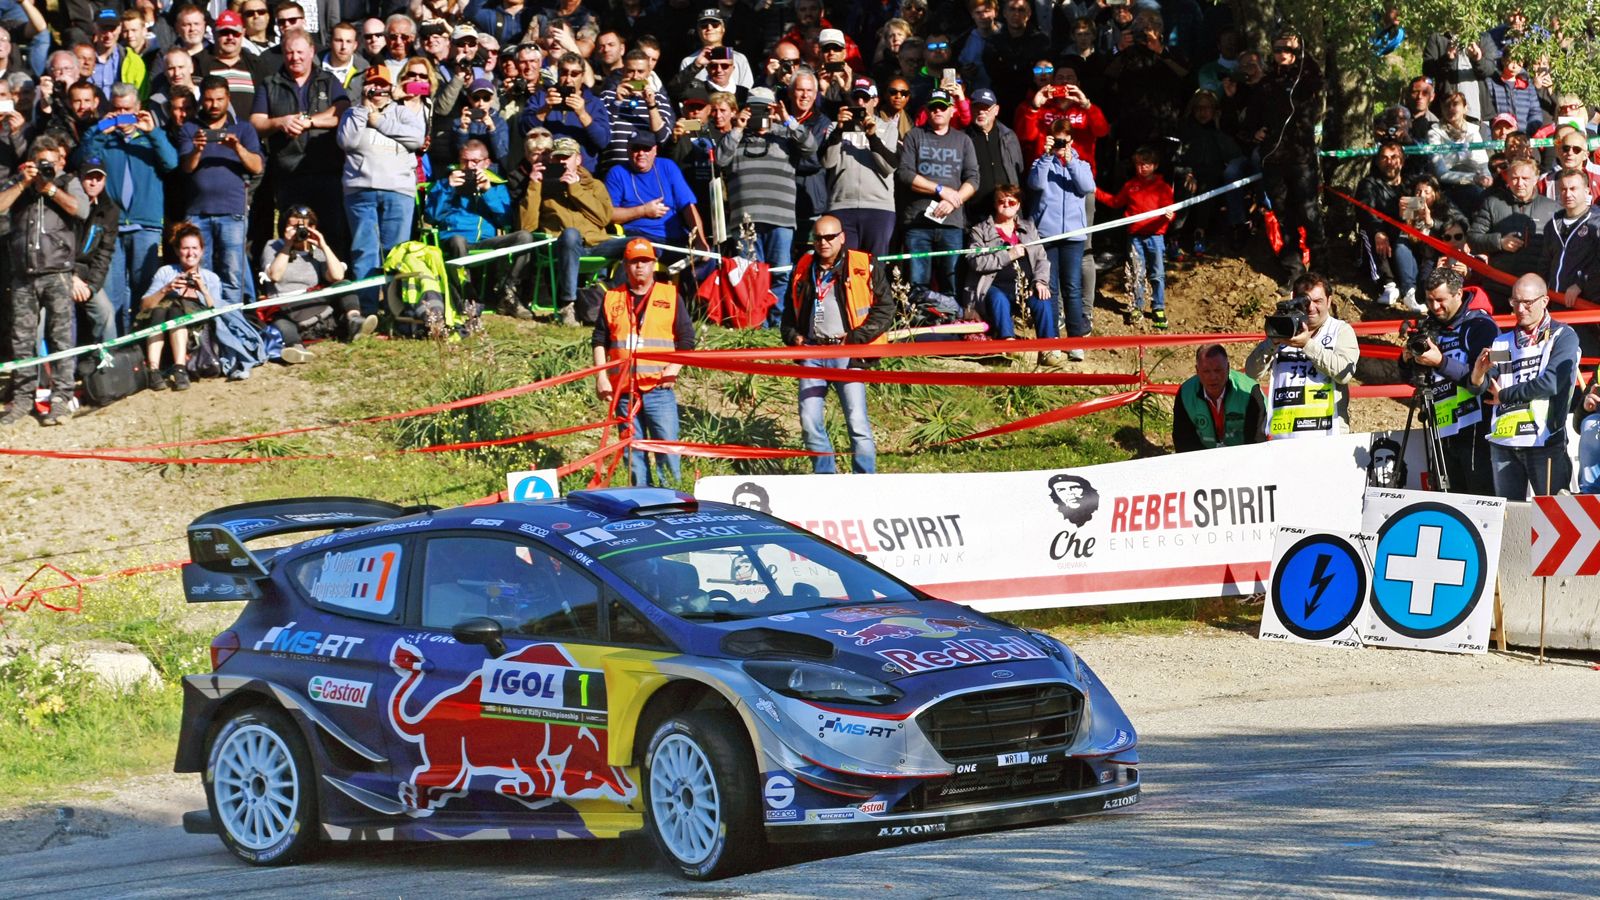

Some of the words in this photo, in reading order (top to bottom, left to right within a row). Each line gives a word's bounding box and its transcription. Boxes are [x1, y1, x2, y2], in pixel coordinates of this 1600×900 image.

[919, 145, 963, 163] EXPL
[918, 161, 953, 178] ORE
[1290, 365, 1318, 380] 334
[1274, 389, 1302, 401] Lexar
[1431, 382, 1453, 395] exar
[1272, 421, 1292, 431] 2017
[614, 520, 650, 532] Ford
[661, 513, 757, 526] EcoBoost
[520, 523, 550, 537] sparco
[578, 531, 603, 543] 1
[655, 524, 743, 541] Lexar
[1049, 530, 1096, 561] Che
[575, 552, 594, 567] ONE
[375, 550, 397, 602] 1
[271, 628, 366, 659] MS-RT
[430, 634, 457, 644] ONE
[875, 638, 986, 673] Red
[961, 635, 1050, 661] Bull
[322, 680, 367, 704] Castrol
[489, 668, 556, 699] IGOL
[578, 673, 589, 707] 1
[512, 707, 528, 716] World
[528, 708, 542, 718] Rally
[542, 709, 579, 721] Championship
[832, 721, 897, 739] MS-RT
[1030, 754, 1049, 765] ONE
[956, 763, 978, 775] ONE
[767, 810, 797, 819] sparco
